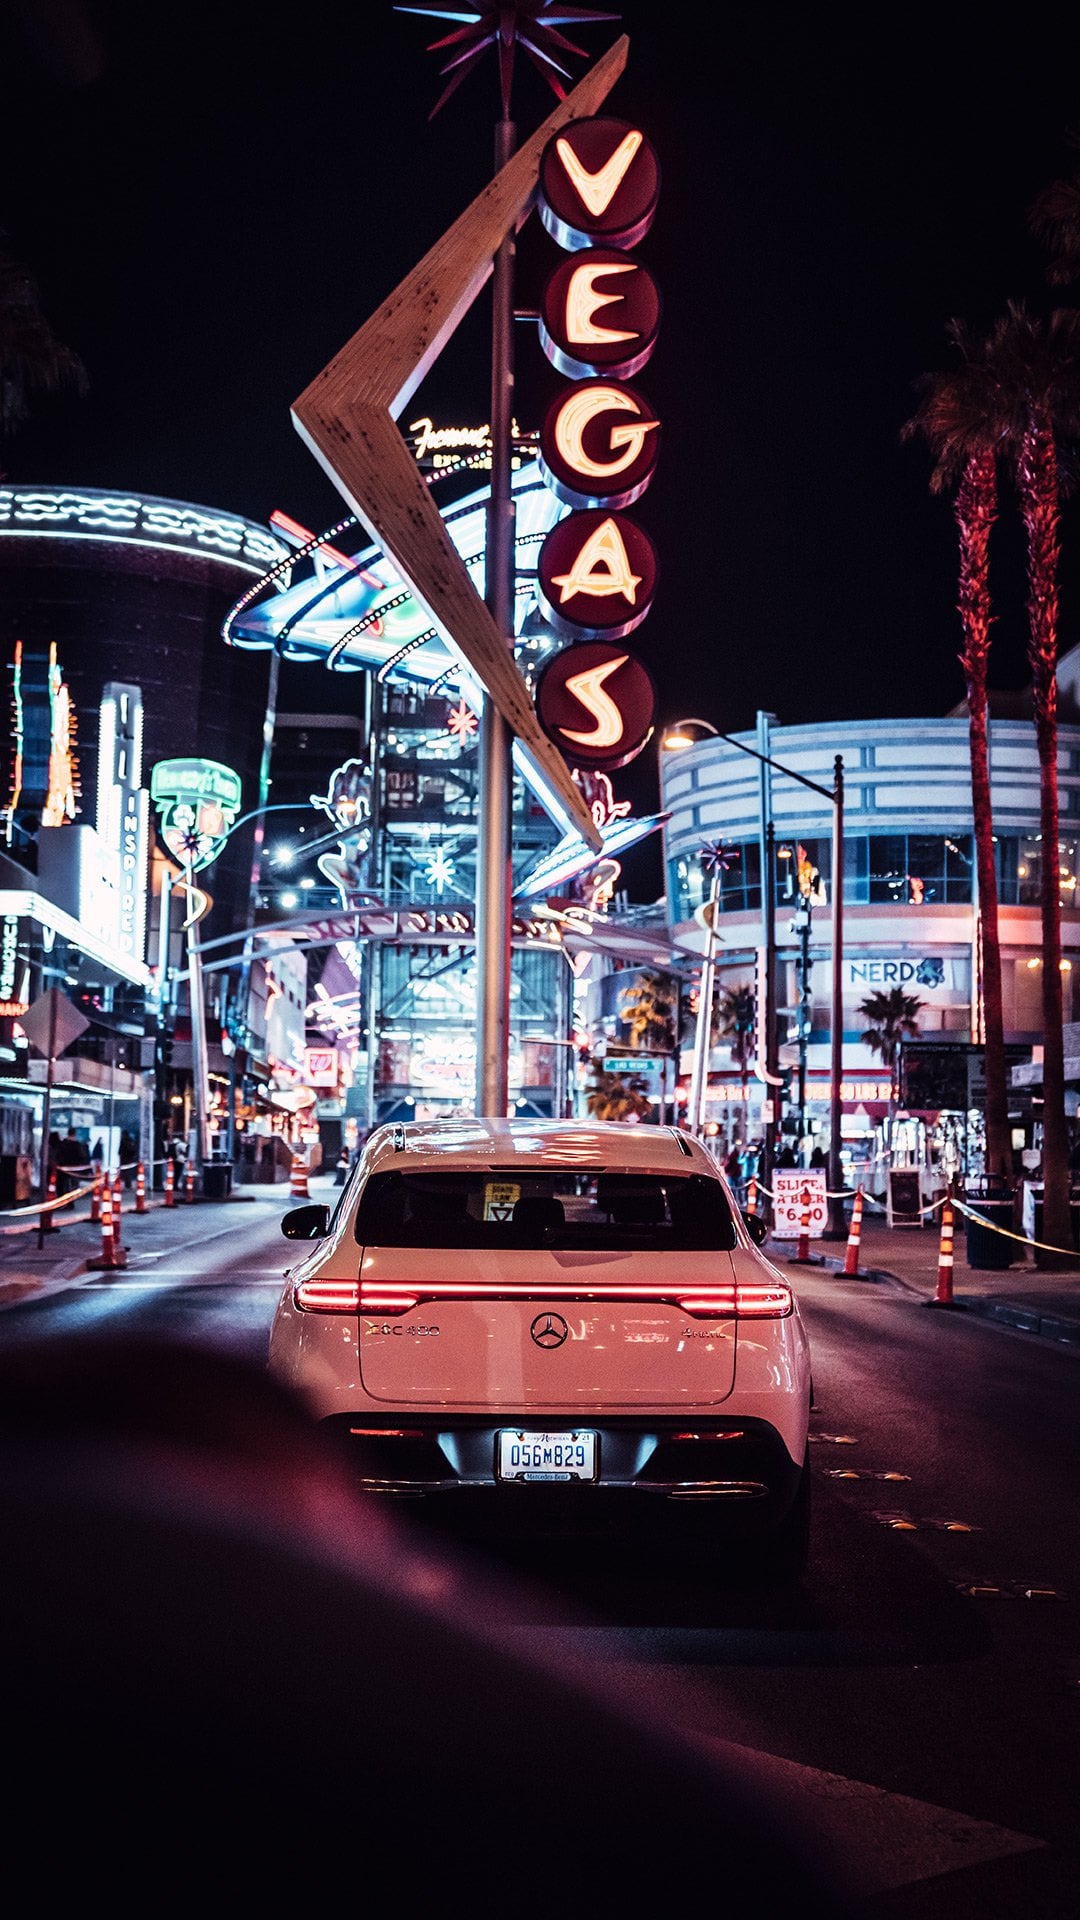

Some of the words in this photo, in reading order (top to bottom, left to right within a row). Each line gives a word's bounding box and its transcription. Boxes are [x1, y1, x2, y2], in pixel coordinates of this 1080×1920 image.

[552, 130, 661, 747] VEGAS
[850, 963, 914, 981] NERD
[791, 1194, 824, 1203] BER
[778, 1208, 823, 1220] $6.0
[511, 1445, 584, 1467] 056M829
